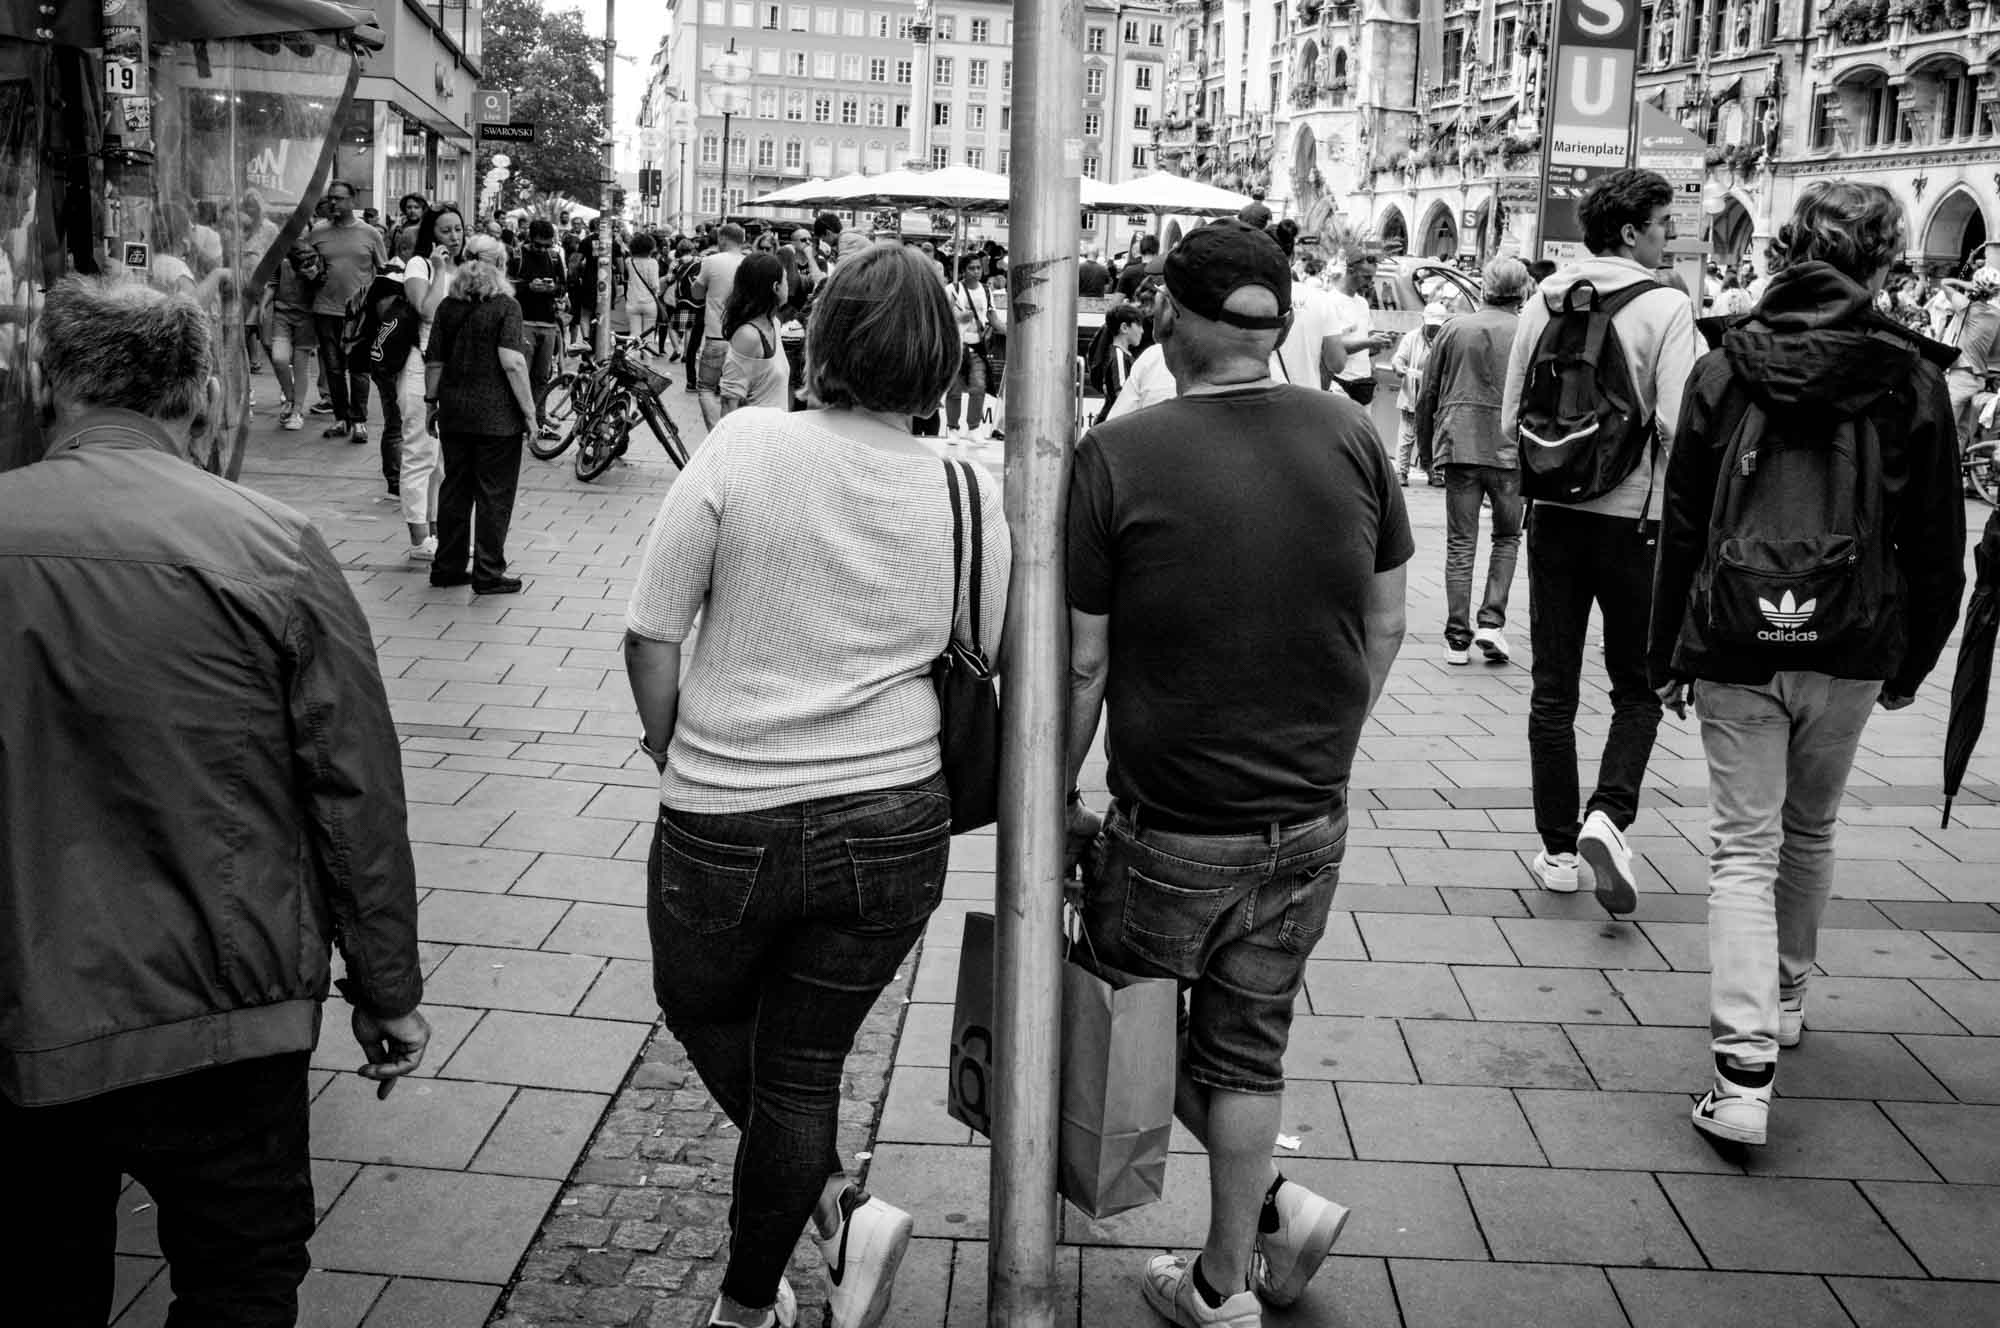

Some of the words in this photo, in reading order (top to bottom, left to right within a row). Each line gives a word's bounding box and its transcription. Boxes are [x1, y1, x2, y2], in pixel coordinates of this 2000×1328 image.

[1571, 55, 1617, 115] U
[484, 127, 533, 136] SWAROVSKI
[1553, 140, 1625, 157] Marienplatz
[1464, 212, 1476, 227] S
[1757, 629, 1818, 642] adidas
